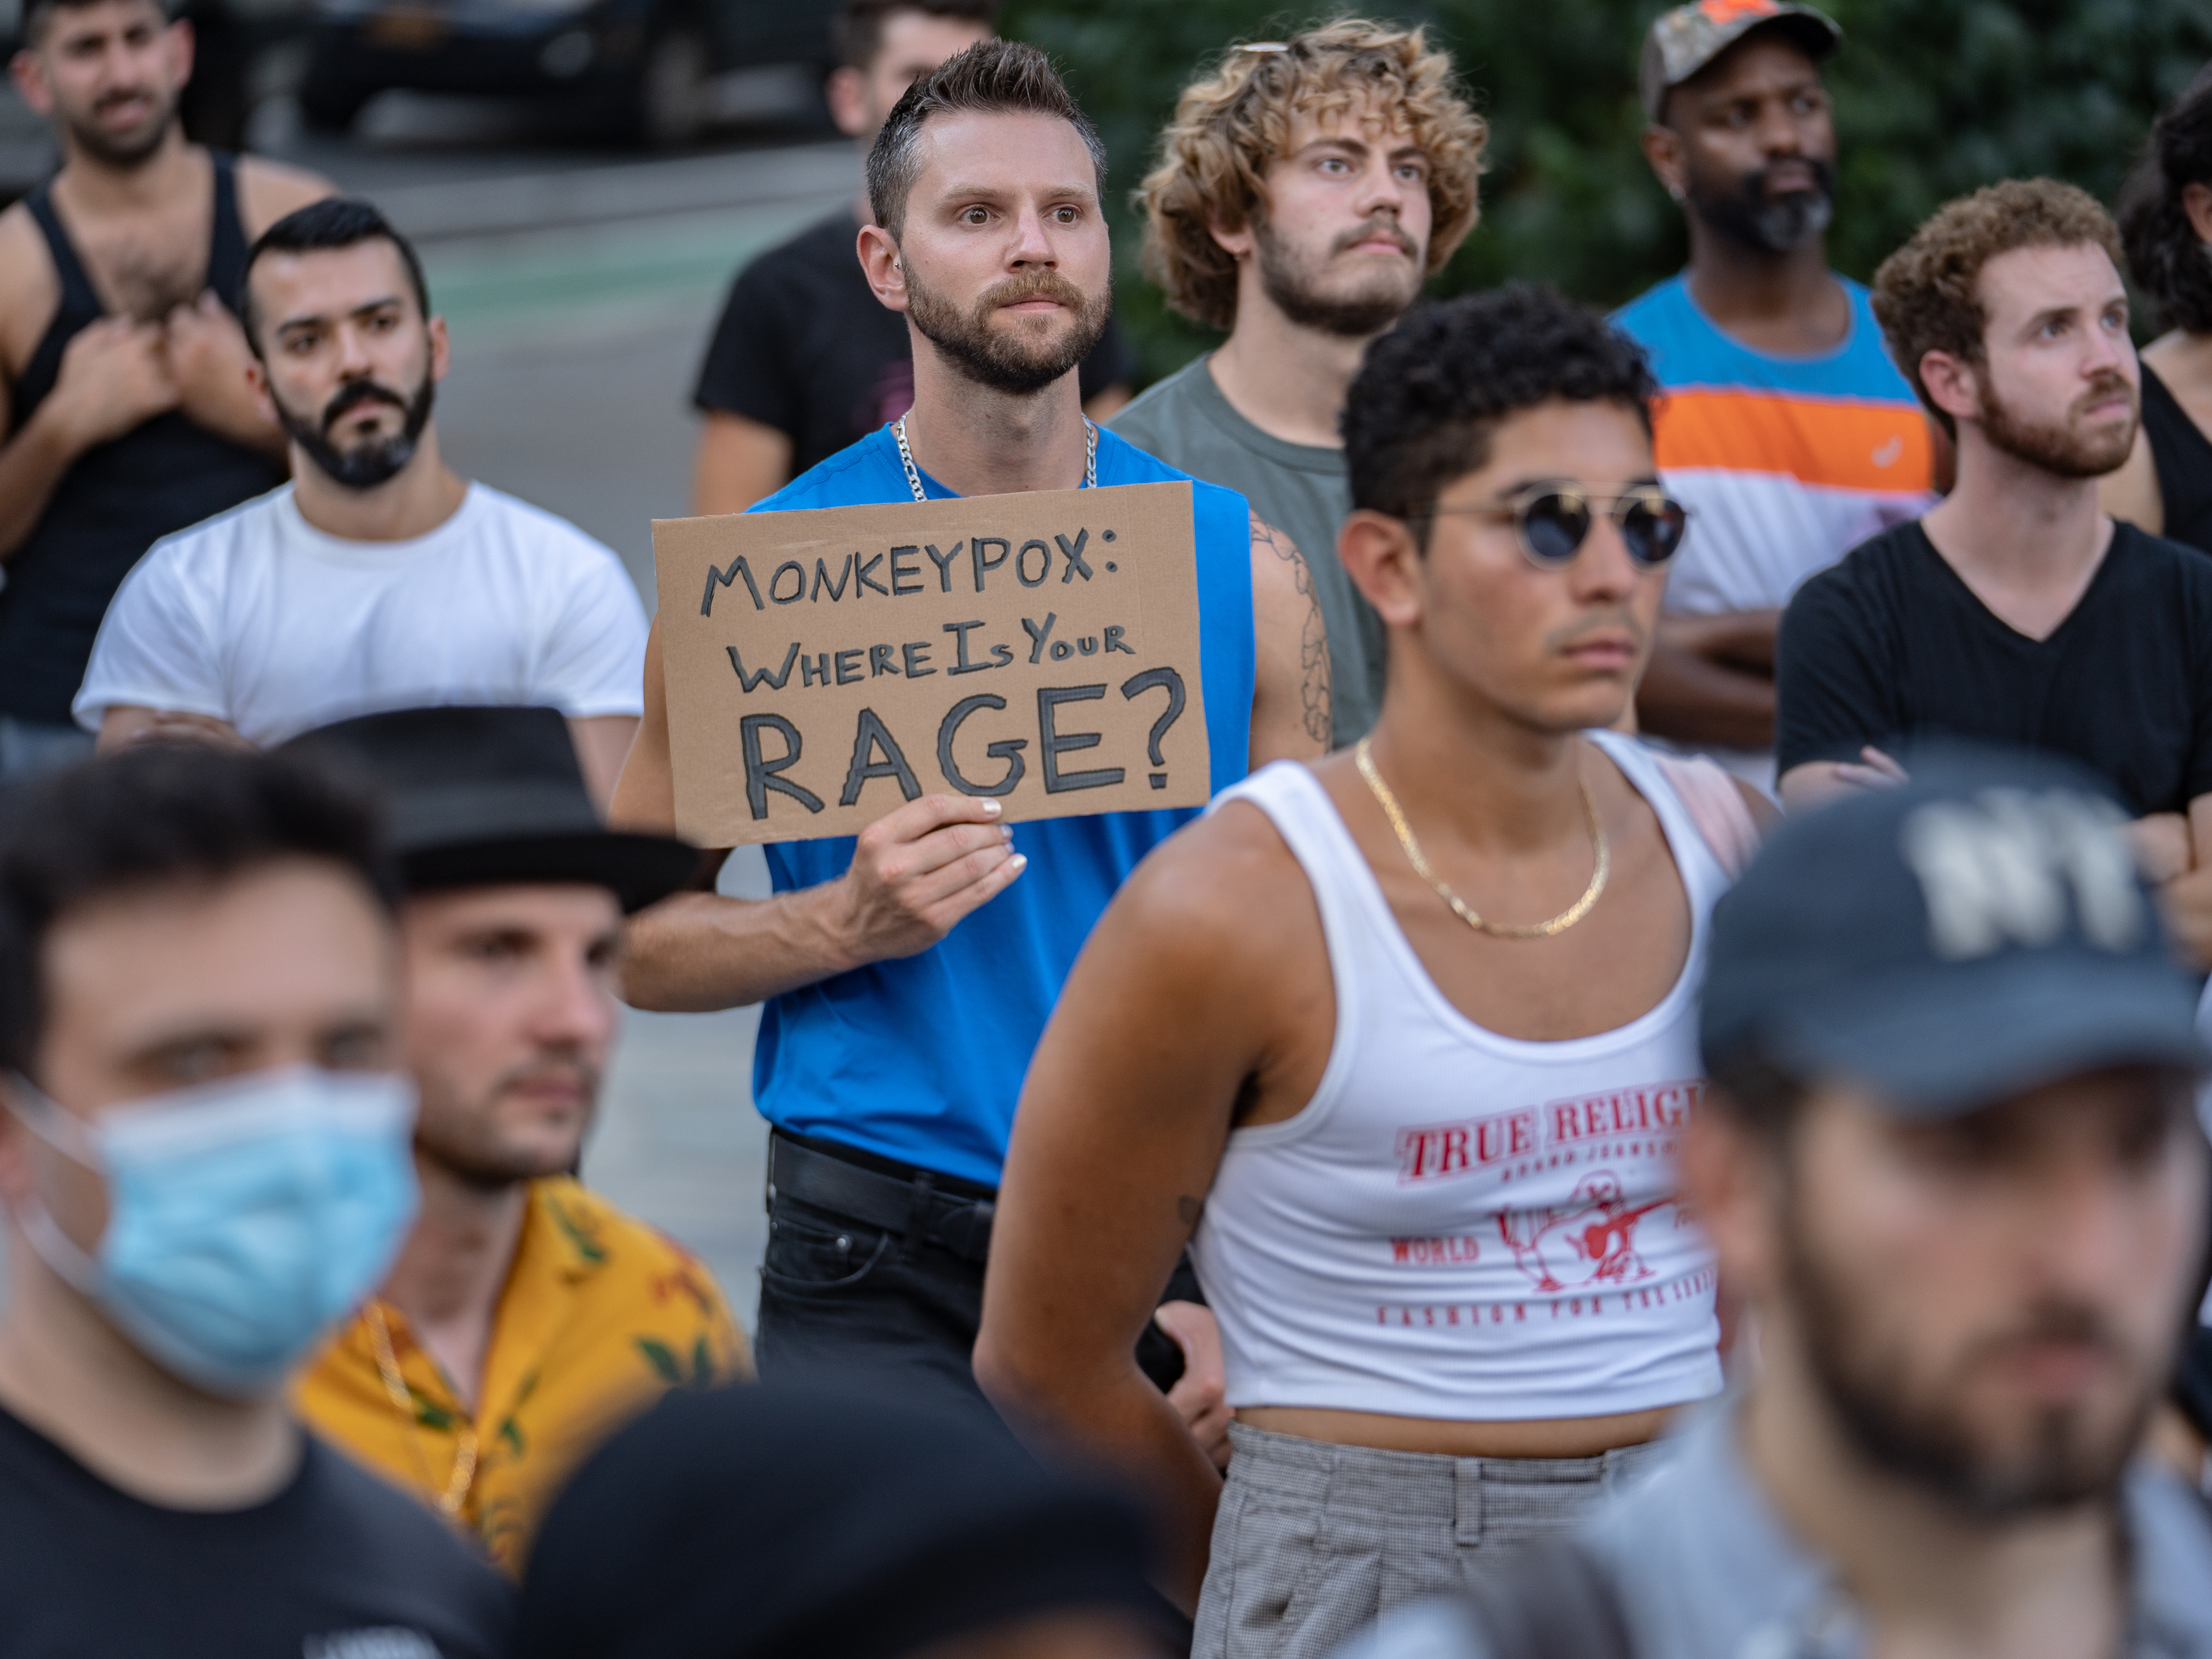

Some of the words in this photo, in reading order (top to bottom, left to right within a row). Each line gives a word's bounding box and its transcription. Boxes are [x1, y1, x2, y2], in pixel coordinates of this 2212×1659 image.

[700, 527, 1118, 617] MONKEYPOX:
[726, 641, 938, 693] WHERE
[740, 667, 1186, 821] RAGE?
[1401, 1111, 1536, 1180] TRUE
[1389, 1234, 1480, 1265] WORLD
[1375, 1301, 1528, 1327] FASHION
[1550, 1294, 1604, 1321] FOR
